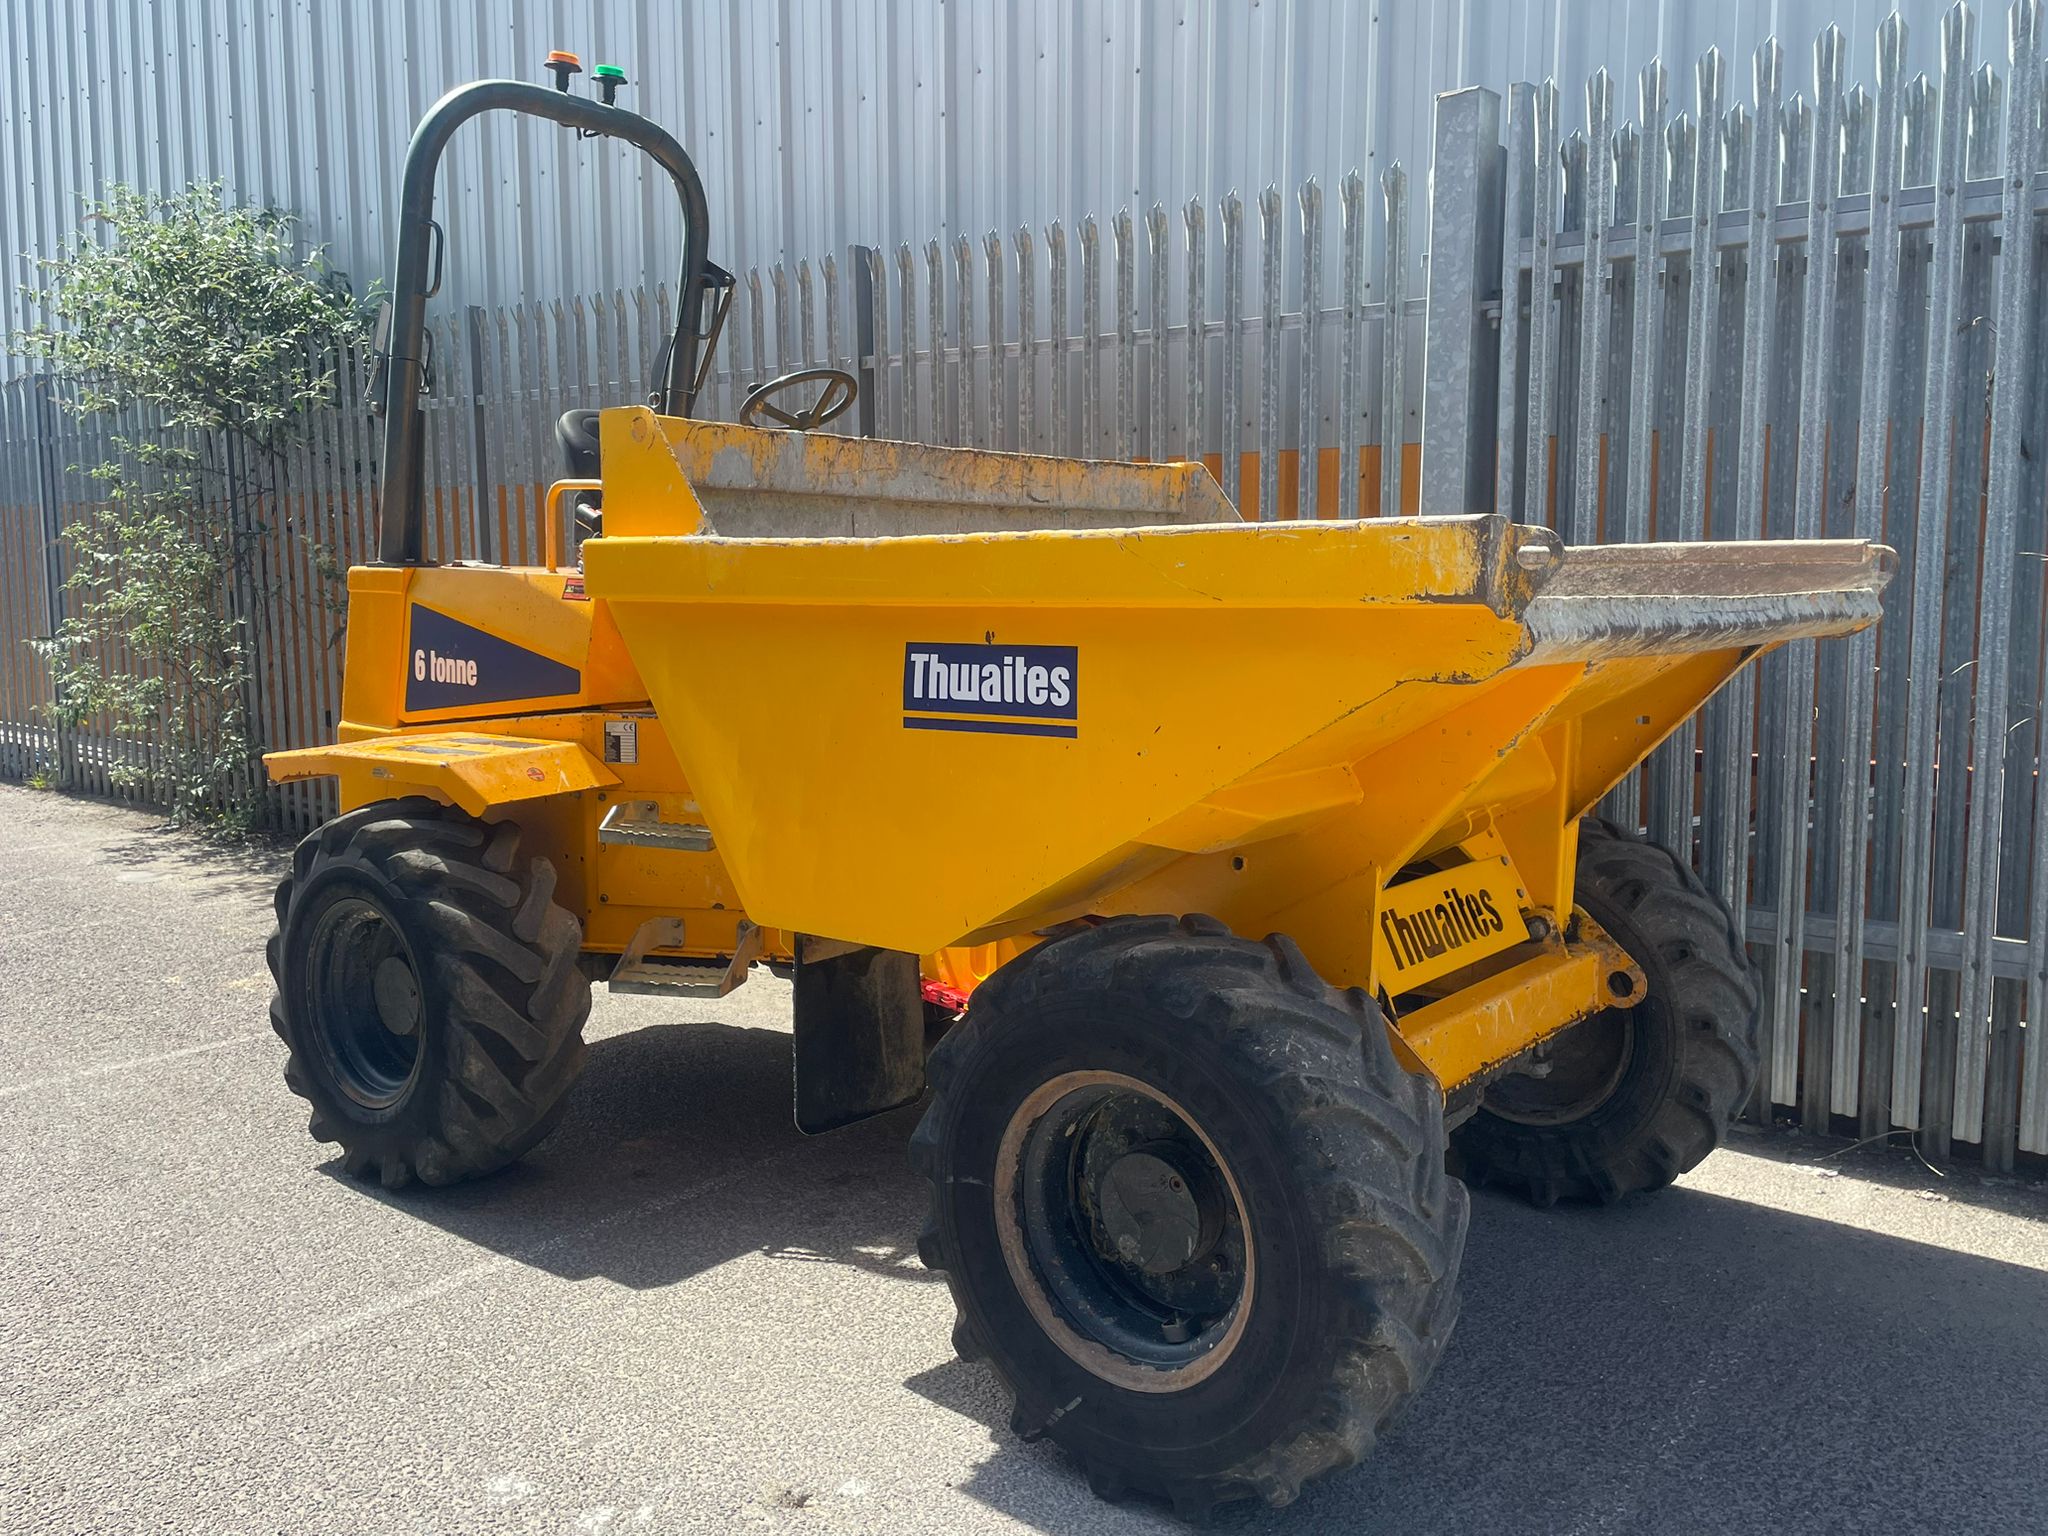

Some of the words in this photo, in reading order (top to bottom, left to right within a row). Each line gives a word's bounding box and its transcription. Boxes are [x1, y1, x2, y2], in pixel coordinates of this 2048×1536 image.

[414, 649, 426, 682] 6
[430, 650, 478, 686] tonne
[910, 653, 1070, 707] Thwaites
[623, 723, 634, 732] CE
